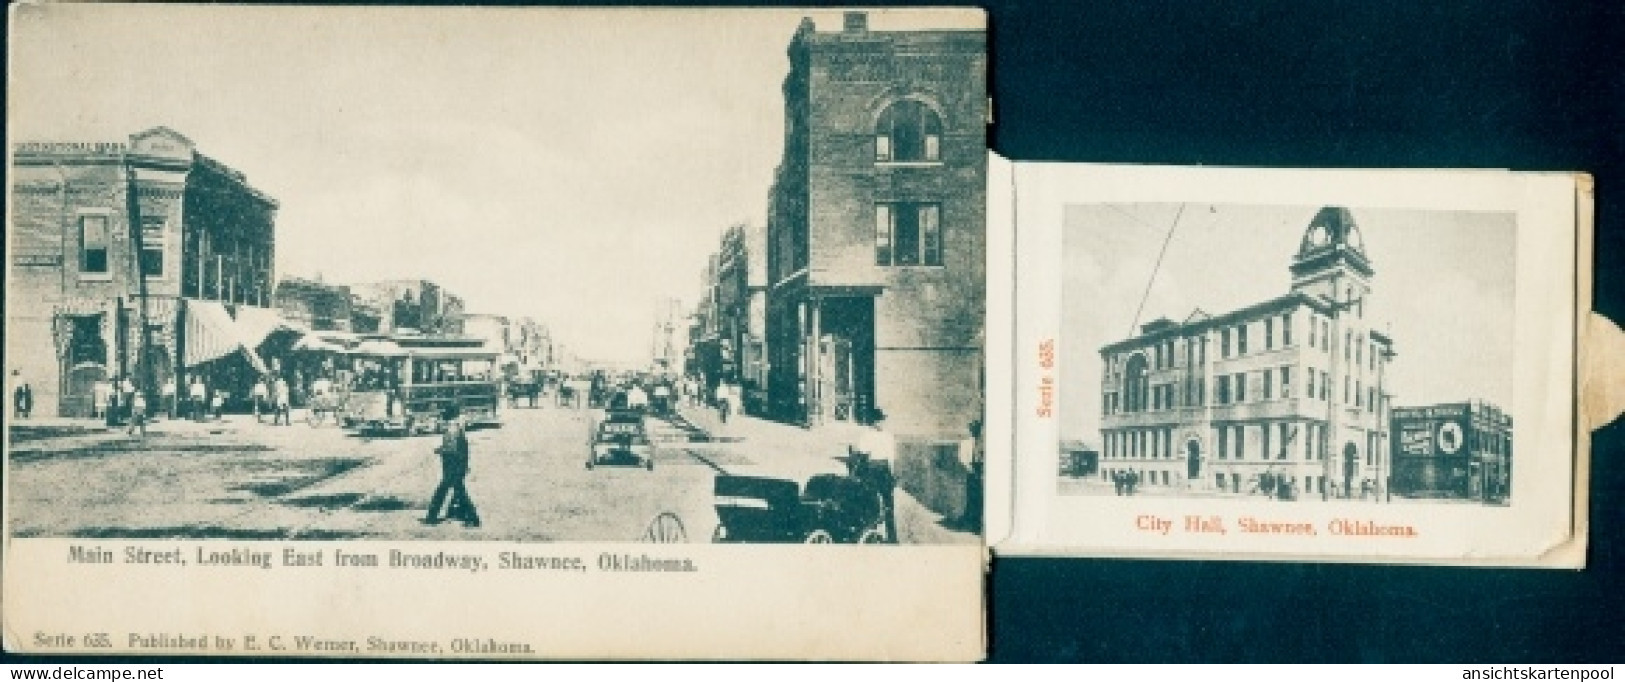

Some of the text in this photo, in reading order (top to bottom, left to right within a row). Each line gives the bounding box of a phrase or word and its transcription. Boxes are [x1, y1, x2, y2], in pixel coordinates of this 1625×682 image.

[1136, 515, 1419, 538] City Hall, Shawnee, Oklahoma.
[67, 545, 698, 573] Main Street, Looking East from Broadway, Shawnee, Oklahoma.
[33, 632, 76, 648] Serie
[128, 632, 208, 649] Published
[215, 633, 236, 650] by
[243, 635, 262, 651] E.
[268, 635, 287, 651] C.
[366, 635, 443, 654] Shawnee,
[451, 637, 536, 654] Oklahoma.
